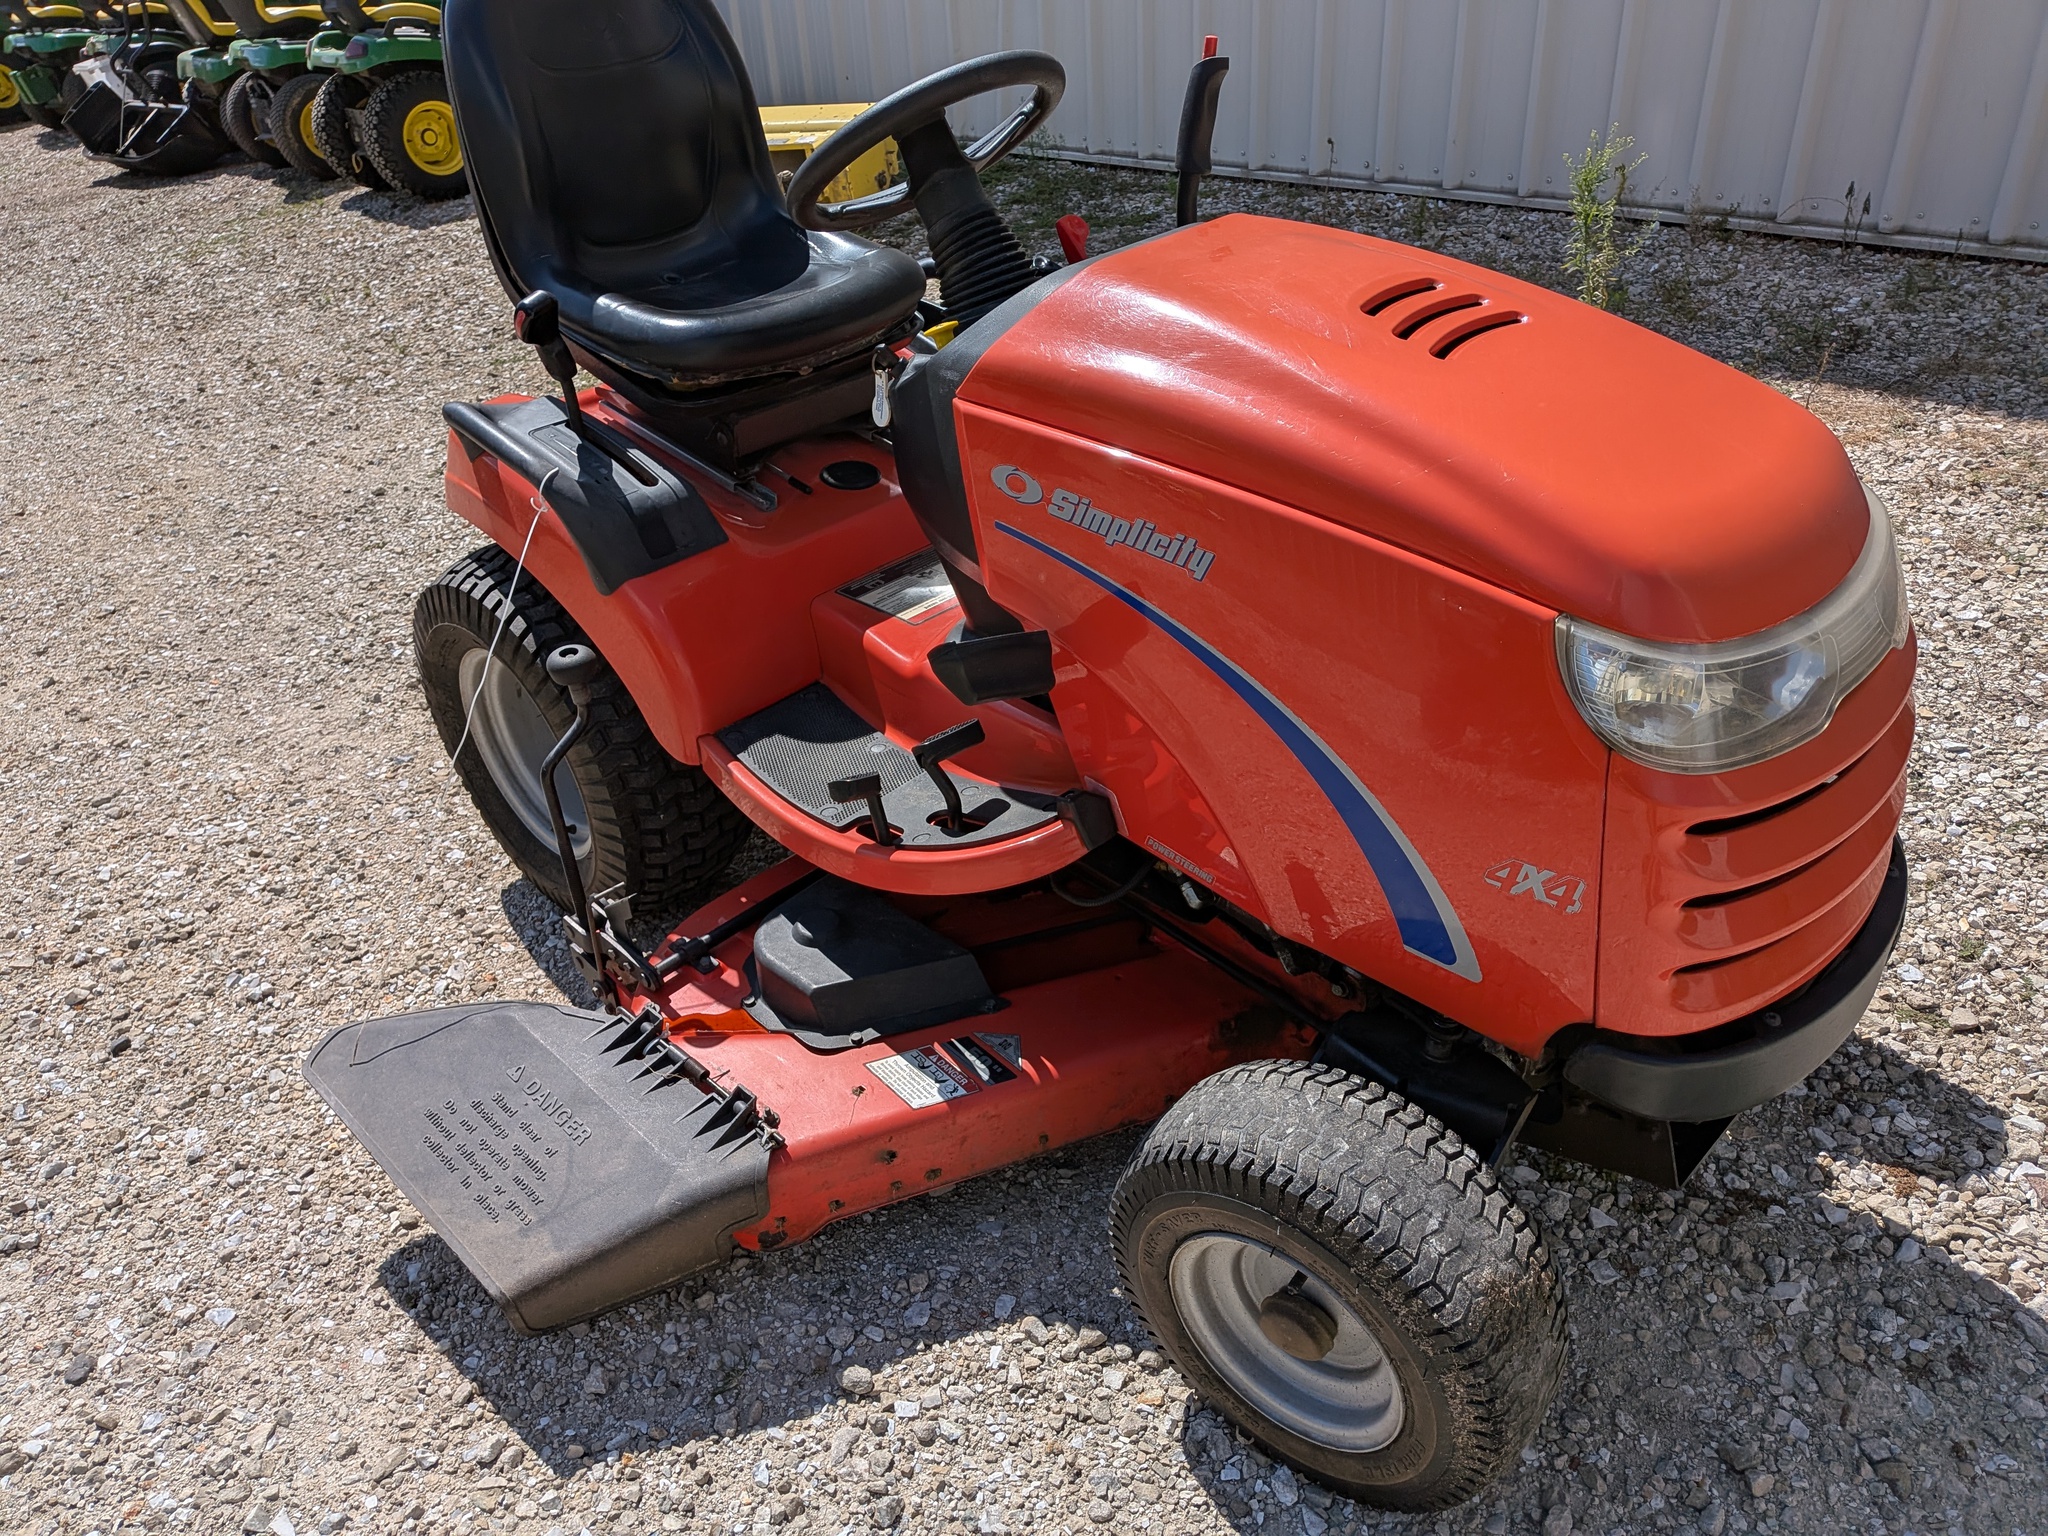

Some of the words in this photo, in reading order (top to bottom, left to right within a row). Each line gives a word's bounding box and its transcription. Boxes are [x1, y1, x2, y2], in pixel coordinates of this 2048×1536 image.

[1047, 488, 1216, 582] Simplicity
[1148, 839, 1175, 860] POWER
[1175, 856, 1214, 883] STEERING
[522, 1078, 593, 1147] DANGER
[936, 1058, 969, 1086] DANGER
[443, 1098, 458, 1115] Do
[459, 1117, 479, 1135] not
[478, 1137, 511, 1171] operate
[512, 1173, 545, 1206] mower
[470, 1099, 509, 1140] discharge
[512, 1142, 548, 1182] opening.
[491, 1091, 519, 1118] Stand
[519, 1120, 542, 1142] clear
[544, 1145, 558, 1158] of
[422, 1134, 460, 1174] collector
[460, 1175, 473, 1190] in
[473, 1192, 501, 1224] place.
[423, 1107, 456, 1141] without
[455, 1142, 493, 1183] deflector
[493, 1184, 506, 1197] or
[504, 1198, 533, 1227] grass
